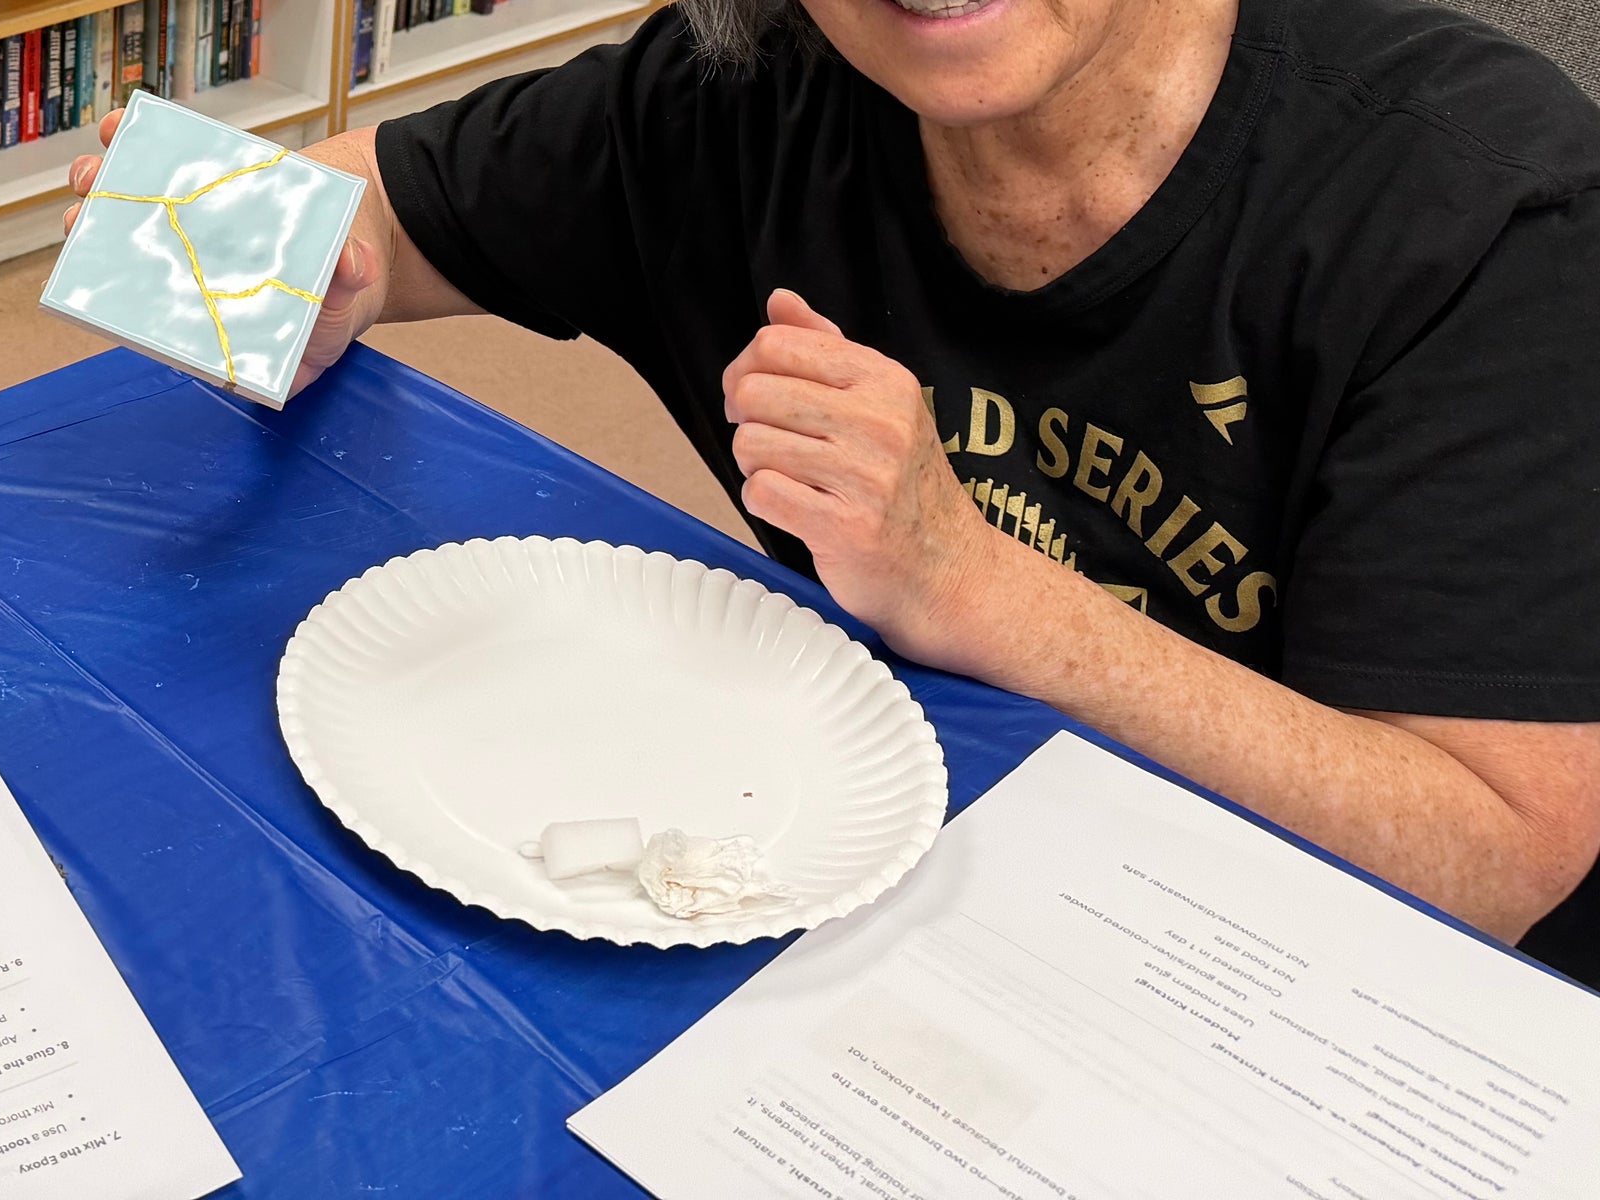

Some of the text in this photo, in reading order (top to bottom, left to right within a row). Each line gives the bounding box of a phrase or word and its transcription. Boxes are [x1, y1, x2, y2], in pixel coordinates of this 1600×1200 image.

[48, 61, 60, 88] DEAVER
[1036, 407, 1278, 632] SERIES
[1058, 892, 1249, 1001] Uses gold/silver-colored powder
[1213, 935, 1297, 984] Not food safe
[1134, 977, 1241, 1042] Modern Kintsugi
[1143, 961, 1255, 1029] Uses modern glue
[3, 1058, 25, 1071] the
[25, 1046, 56, 1062] Glue
[56, 1040, 70, 1050] 8.
[31, 1100, 55, 1114] Mix
[19, 1130, 122, 1175] 7. Mix the Epoxy
[732, 1126, 833, 1199] urushi, a natural
